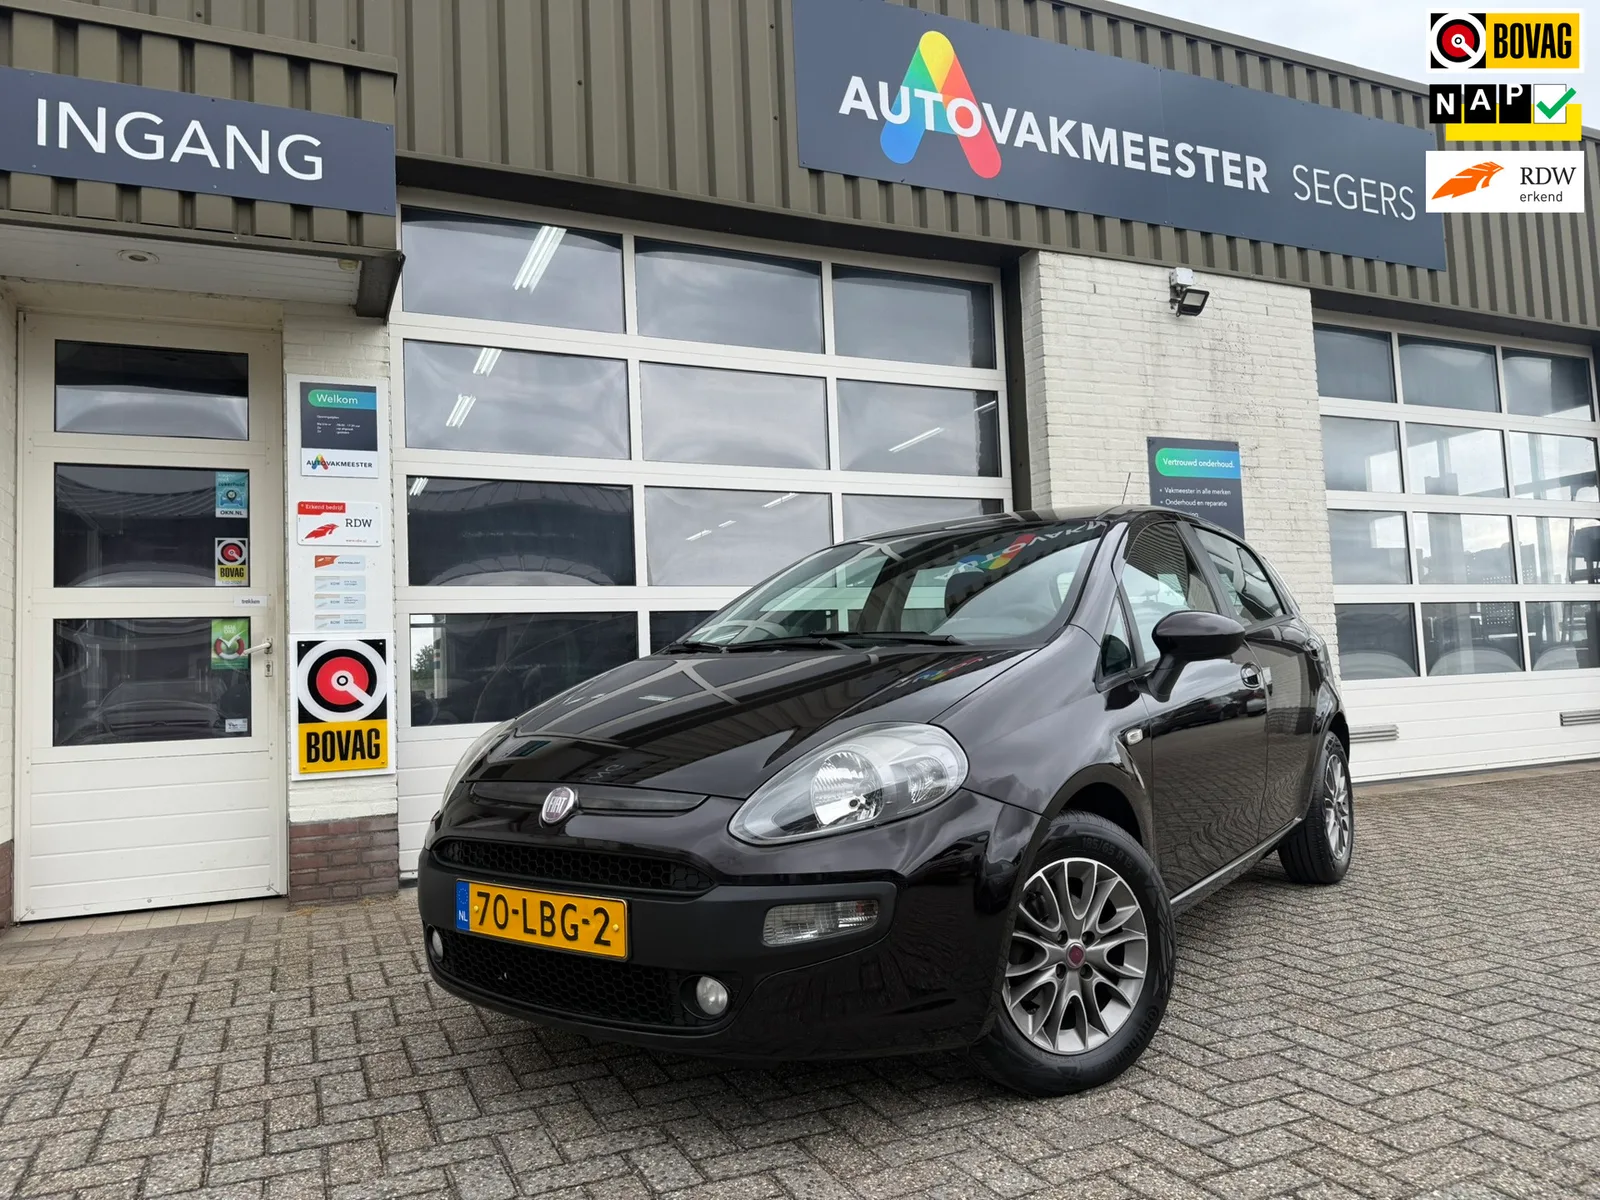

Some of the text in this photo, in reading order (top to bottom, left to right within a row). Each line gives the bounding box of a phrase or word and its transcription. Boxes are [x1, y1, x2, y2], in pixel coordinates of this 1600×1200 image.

[36, 98, 324, 181] INGANG
[838, 75, 1416, 221] AUTOVAKMEESTER SEGERS
[316, 393, 358, 405] Welkom
[306, 458, 373, 469] AUTOVAKMEESTER
[1163, 457, 1235, 468] Vertrouwd onderhoud.
[345, 518, 372, 528] RDW
[220, 567, 244, 578] BOVAG
[306, 728, 381, 763] BOVAG
[546, 796, 568, 814] FIAT
[458, 910, 468, 922] NL
[477, 891, 611, 947] 70-LBG-2
